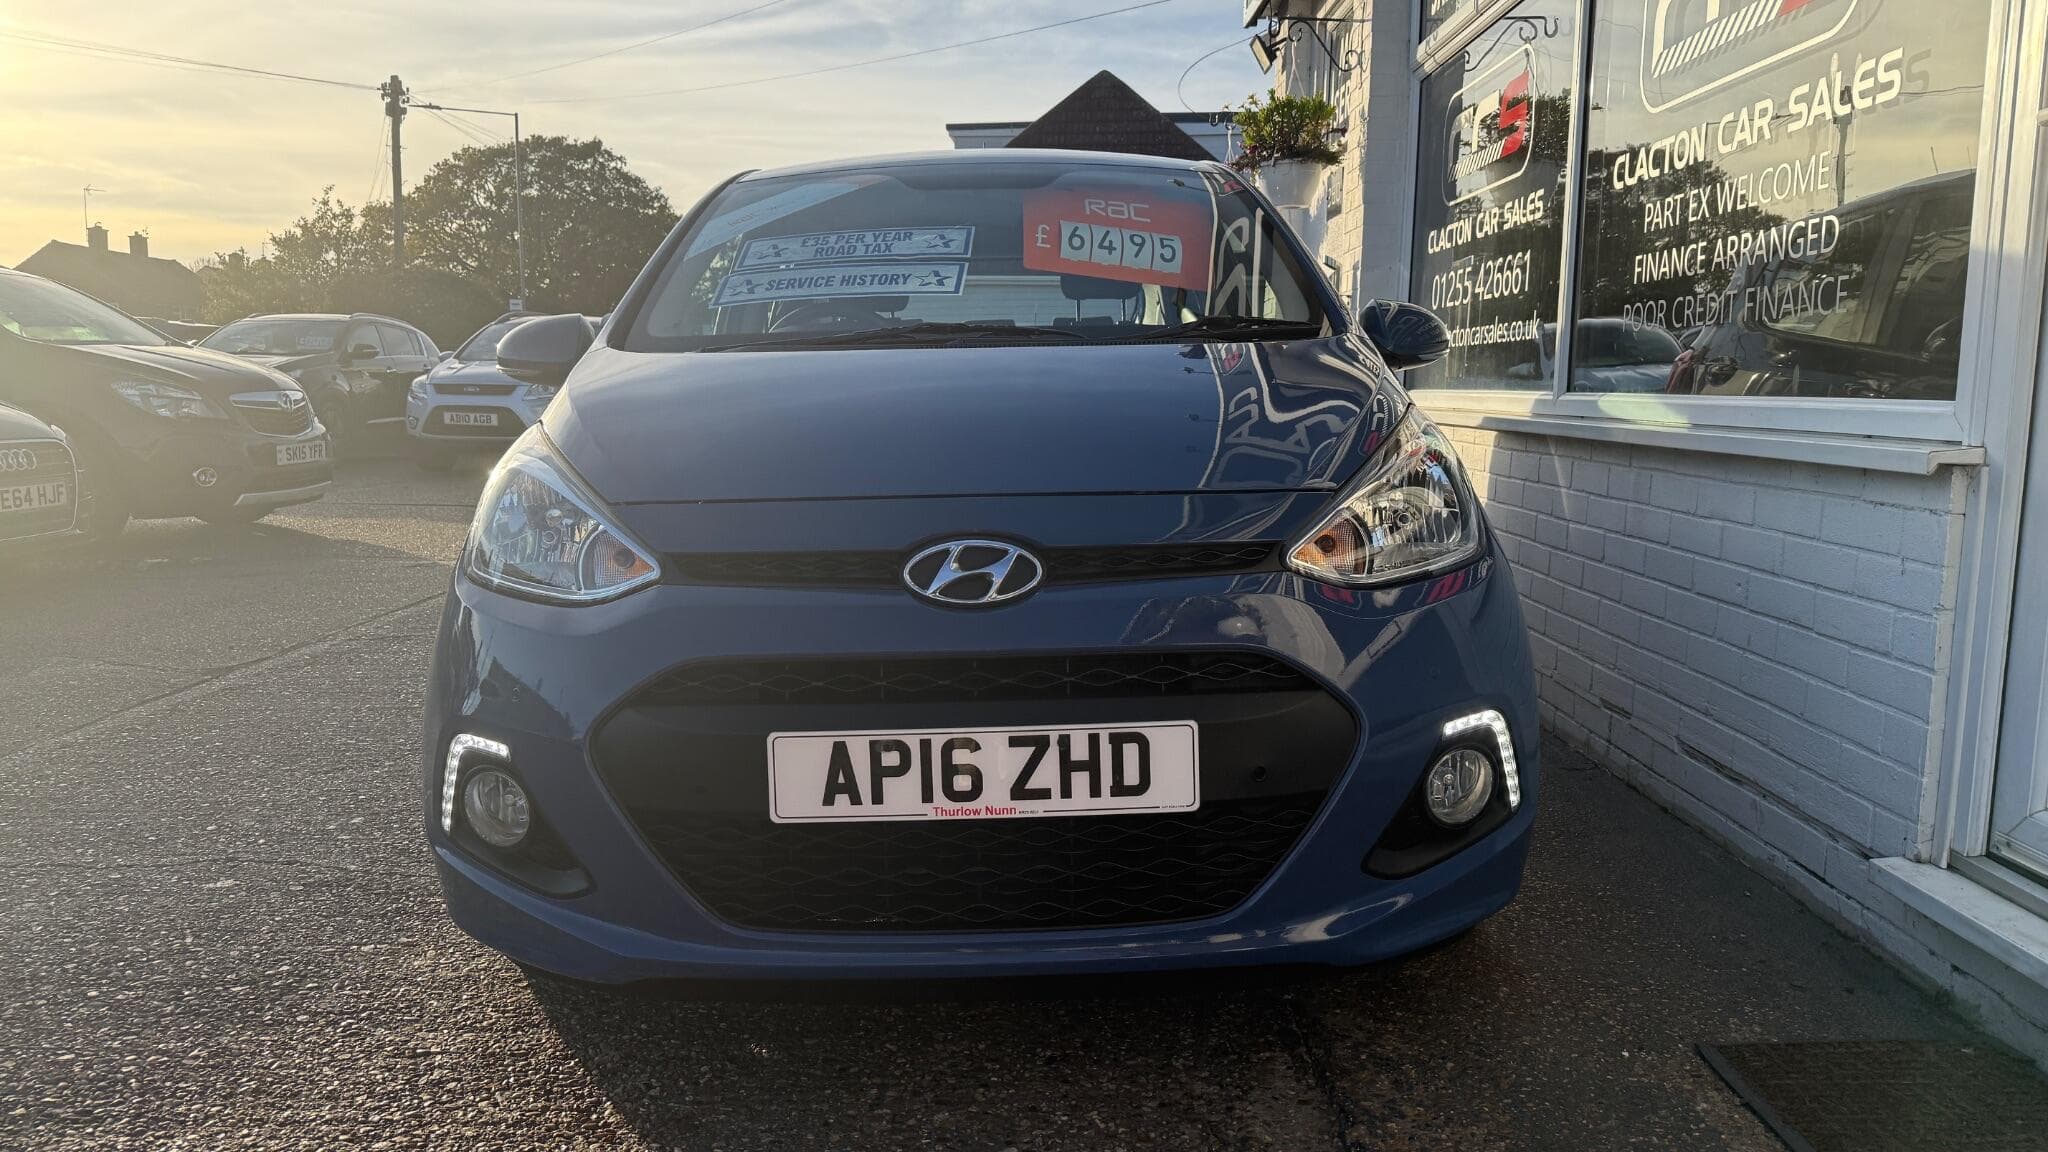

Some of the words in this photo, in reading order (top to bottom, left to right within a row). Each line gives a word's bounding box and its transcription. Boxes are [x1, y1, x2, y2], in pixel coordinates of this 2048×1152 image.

[1613, 122, 1707, 190] CLACTON
[1717, 98, 1775, 154] CAR
[1787, 48, 1903, 134] SALES
[1427, 217, 1472, 255] CLACTON
[1475, 207, 1499, 239] CAR
[1503, 188, 1545, 230] SALES
[1643, 193, 1685, 234] PART
[1688, 185, 1711, 222] EX
[1716, 151, 1831, 213] WELCOME
[800, 236, 832, 248] £35
[833, 234, 866, 245] PER
[872, 231, 914, 242] YEAR
[813, 244, 858, 258] ROAD
[863, 242, 895, 255] TAX
[1035, 223, 1052, 249] £
[1066, 225, 1177, 264] 6495
[1633, 241, 1706, 285] FINANCE
[1711, 214, 1840, 272] ARRANGED
[765, 276, 834, 292] SERVICE
[839, 273, 913, 287] HISTORY
[1431, 266, 1473, 311] 01255
[1475, 249, 1531, 300] 426661
[1622, 300, 1666, 333] POOR
[1671, 288, 1737, 328] CREDIT
[1742, 275, 1850, 322] FINANCE
[1449, 309, 1540, 348] ctoncarsales.co.uk
[822, 736, 984, 807] AP16
[1008, 731, 1151, 800] ZHD
[933, 806, 981, 817] Thurlow
[985, 805, 1017, 816] Nunn
